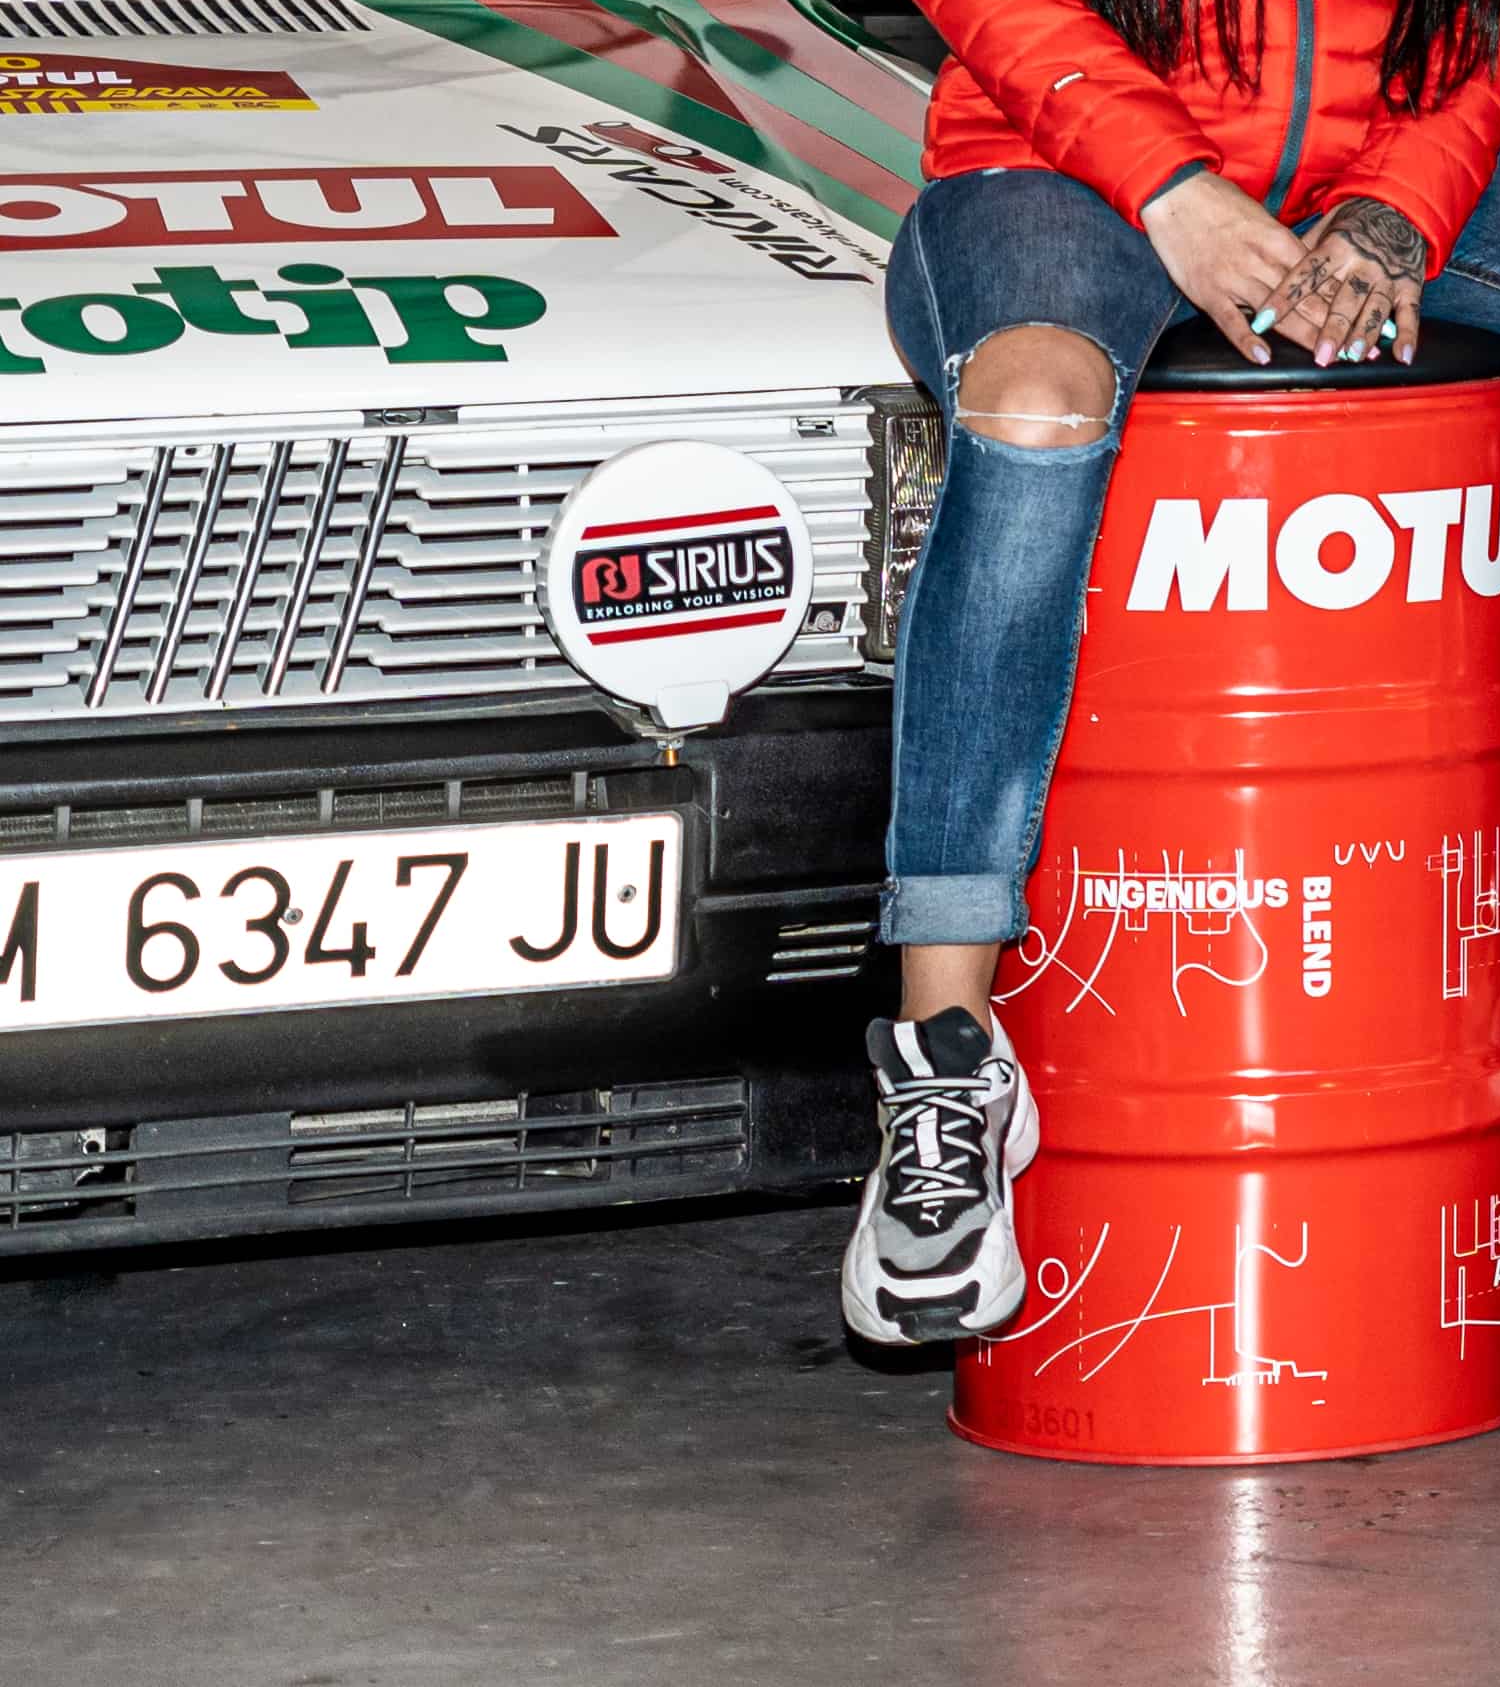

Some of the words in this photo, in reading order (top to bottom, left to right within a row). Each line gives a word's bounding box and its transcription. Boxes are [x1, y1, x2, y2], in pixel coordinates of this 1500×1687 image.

[0, 71, 133, 86] TUL
[0, 87, 88, 99] STA
[98, 86, 270, 98] BRAVA
[0, 174, 556, 240] OTUL
[646, 537, 784, 596] SIRIUS
[586, 599, 674, 620] EXPLORING
[683, 594, 724, 609] YOUR
[732, 585, 786, 602] VISION
[126, 852, 470, 993] 6347
[508, 839, 666, 964] JU
[1083, 876, 1289, 910] INGENIOUS
[1302, 875, 1331, 998] BLEND
